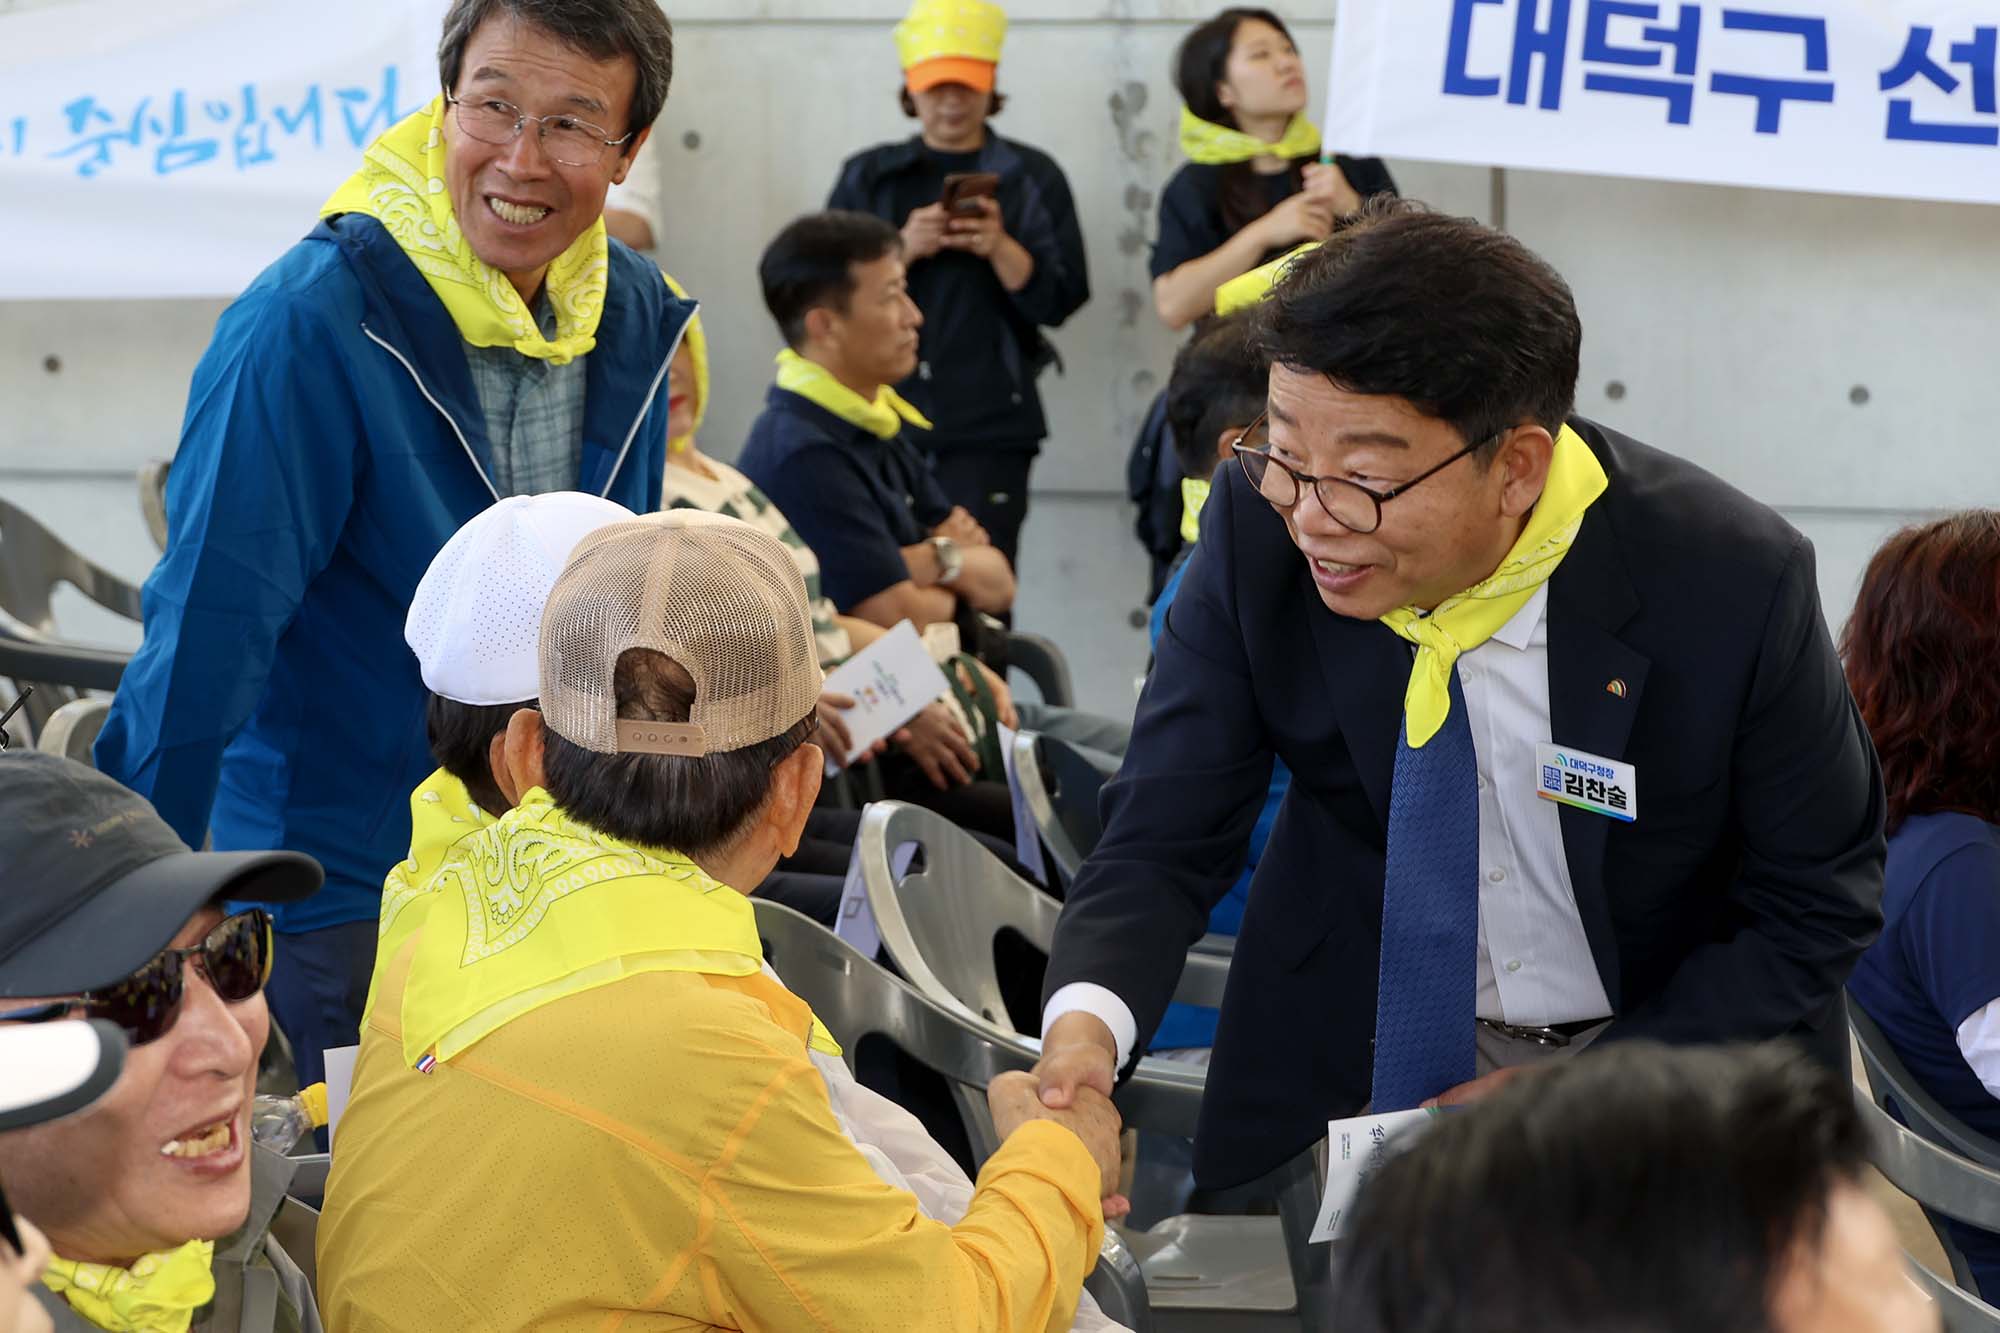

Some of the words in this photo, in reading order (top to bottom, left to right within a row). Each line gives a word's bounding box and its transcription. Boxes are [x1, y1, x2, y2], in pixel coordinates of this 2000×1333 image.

[1442, 0, 1834, 134] 대덕구
[46, 65, 415, 180] 중심입니다
[1564, 771, 1627, 810] 김찬술
[1569, 758, 1615, 780] 대덕구청장
